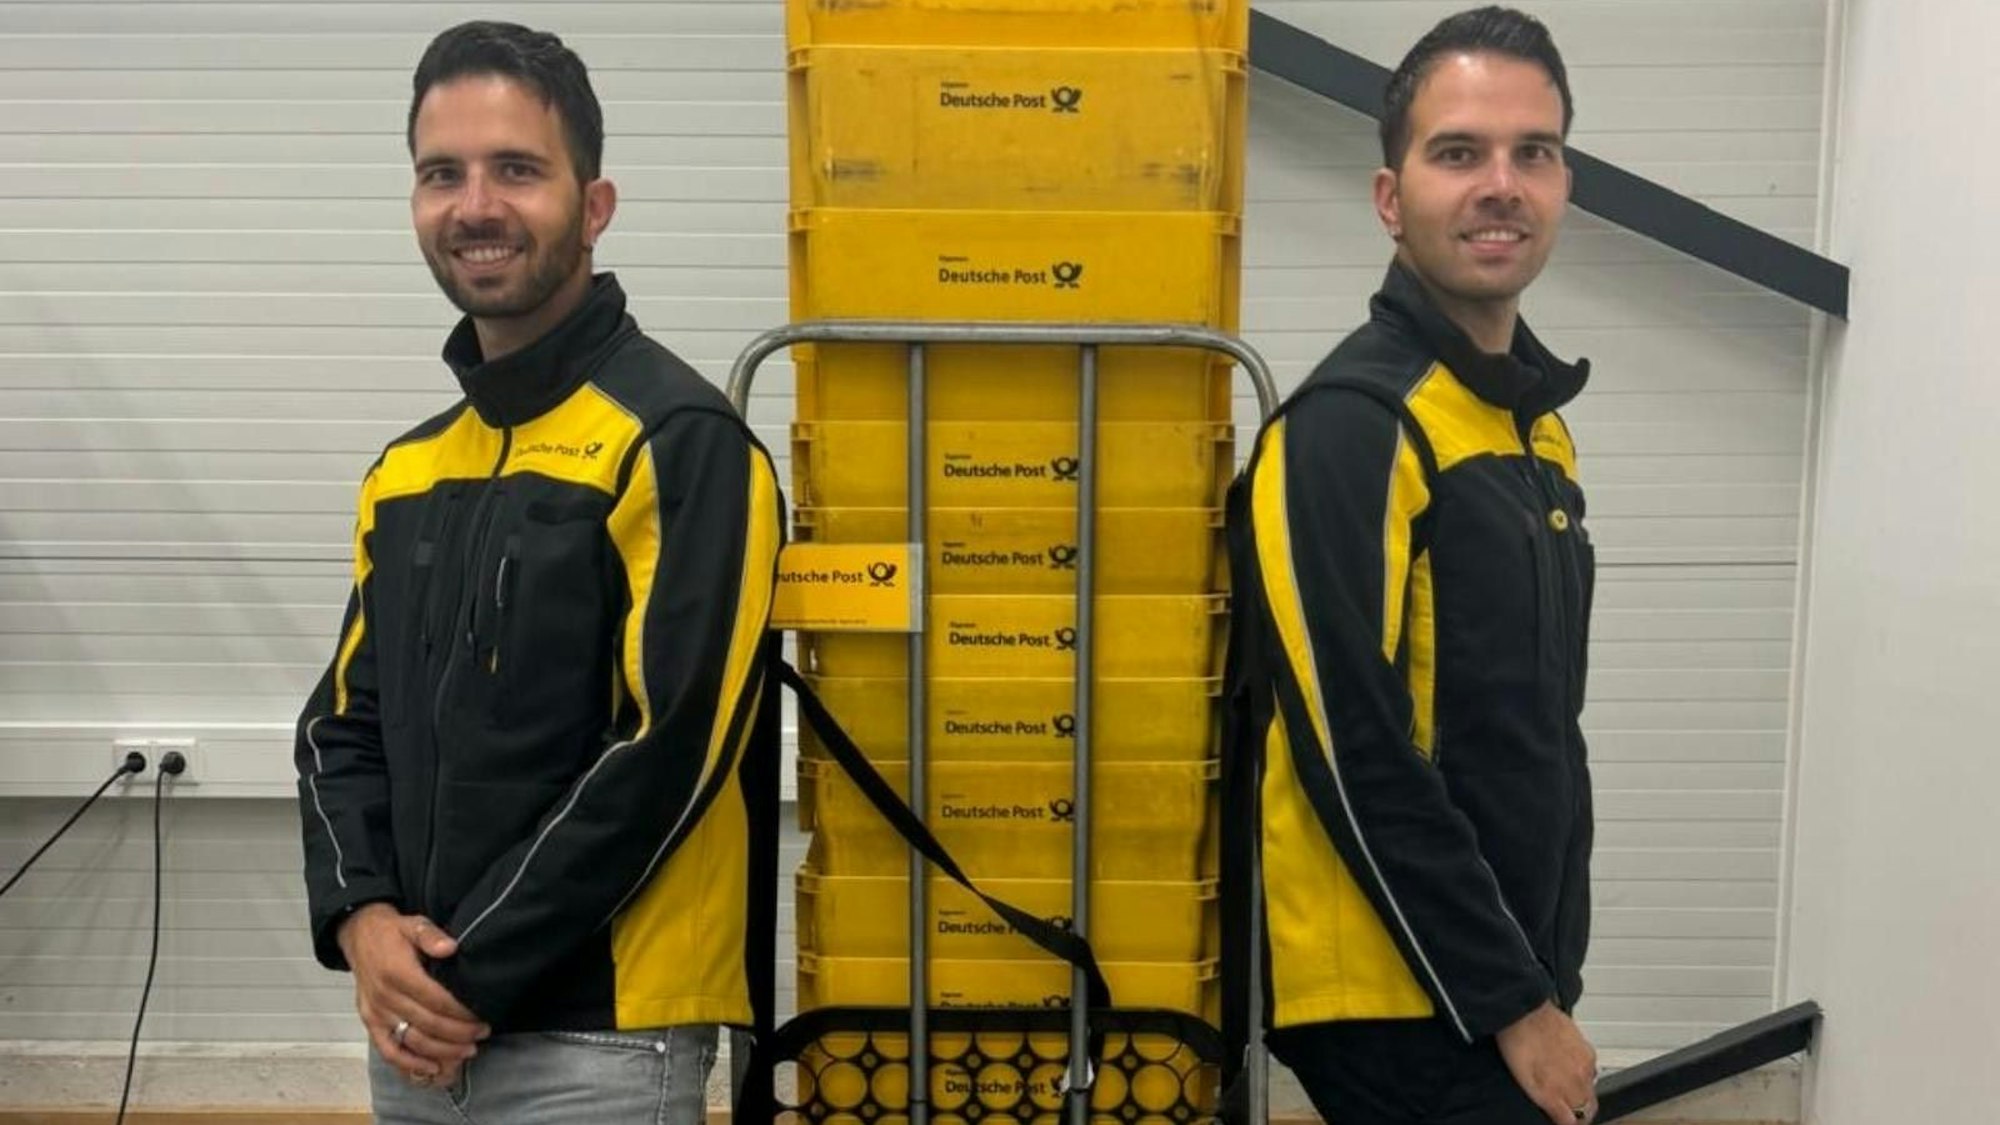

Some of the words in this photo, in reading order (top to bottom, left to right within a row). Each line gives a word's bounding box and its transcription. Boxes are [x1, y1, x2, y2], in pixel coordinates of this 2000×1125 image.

[940, 92, 1010, 107] Deutsche
[1013, 94, 1046, 108] Post
[939, 268, 1010, 283] Deutsche
[1014, 270, 1046, 284] Post
[944, 464, 1011, 477] Deutsche
[1015, 464, 1046, 478] Post
[942, 551, 1009, 565] Deutsche
[1012, 552, 1044, 565] Post
[779, 570, 828, 583] utsche
[832, 569, 864, 583] Post
[949, 632, 1016, 646] Deutsche
[1019, 633, 1050, 647] Post
[945, 720, 1012, 734] Deutsche
[1016, 721, 1046, 735] Post
[942, 804, 1010, 818] Deutsche
[1012, 805, 1043, 818] Post
[938, 921, 1005, 935] Deutsche
[945, 1081, 1012, 1095] Deusche
[1015, 1081, 1046, 1095] Pst
